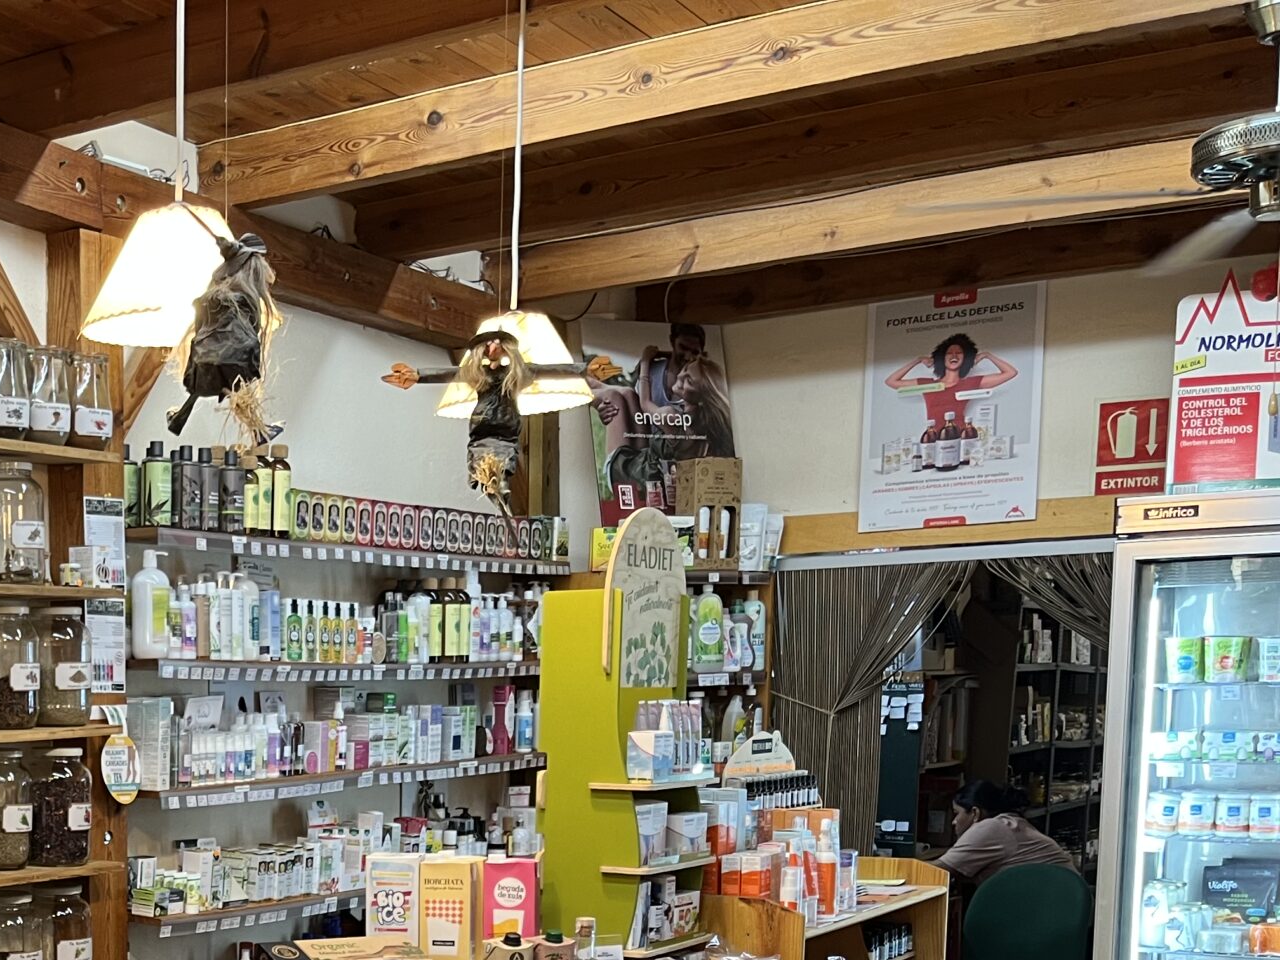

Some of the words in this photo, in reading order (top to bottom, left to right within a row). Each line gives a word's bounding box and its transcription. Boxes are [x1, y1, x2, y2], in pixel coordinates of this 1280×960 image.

[886, 312, 946, 328] FORTALECE
[947, 309, 967, 320] LAS
[969, 302, 1025, 317] DEFENSAS
[1177, 386, 1223, 396] COMPLEMENTO
[1182, 400, 1227, 410] CONTROL
[1229, 397, 1248, 407] DEL
[1181, 407, 1243, 419] COLESTEROL
[634, 412, 692, 431] enercap
[1181, 419, 1187, 428] Y
[1190, 418, 1203, 428] DE
[1204, 417, 1224, 427] LOS
[1180, 424, 1254, 437] TRIGLICÉRIDOS
[1100, 475, 1159, 490] EXTINTOR
[1158, 506, 1195, 519] infrico
[627, 543, 675, 572] ELADIET
[424, 878, 464, 886] HORCHATA
[497, 884, 525, 894] beguda
[310, 941, 358, 952] Organic
